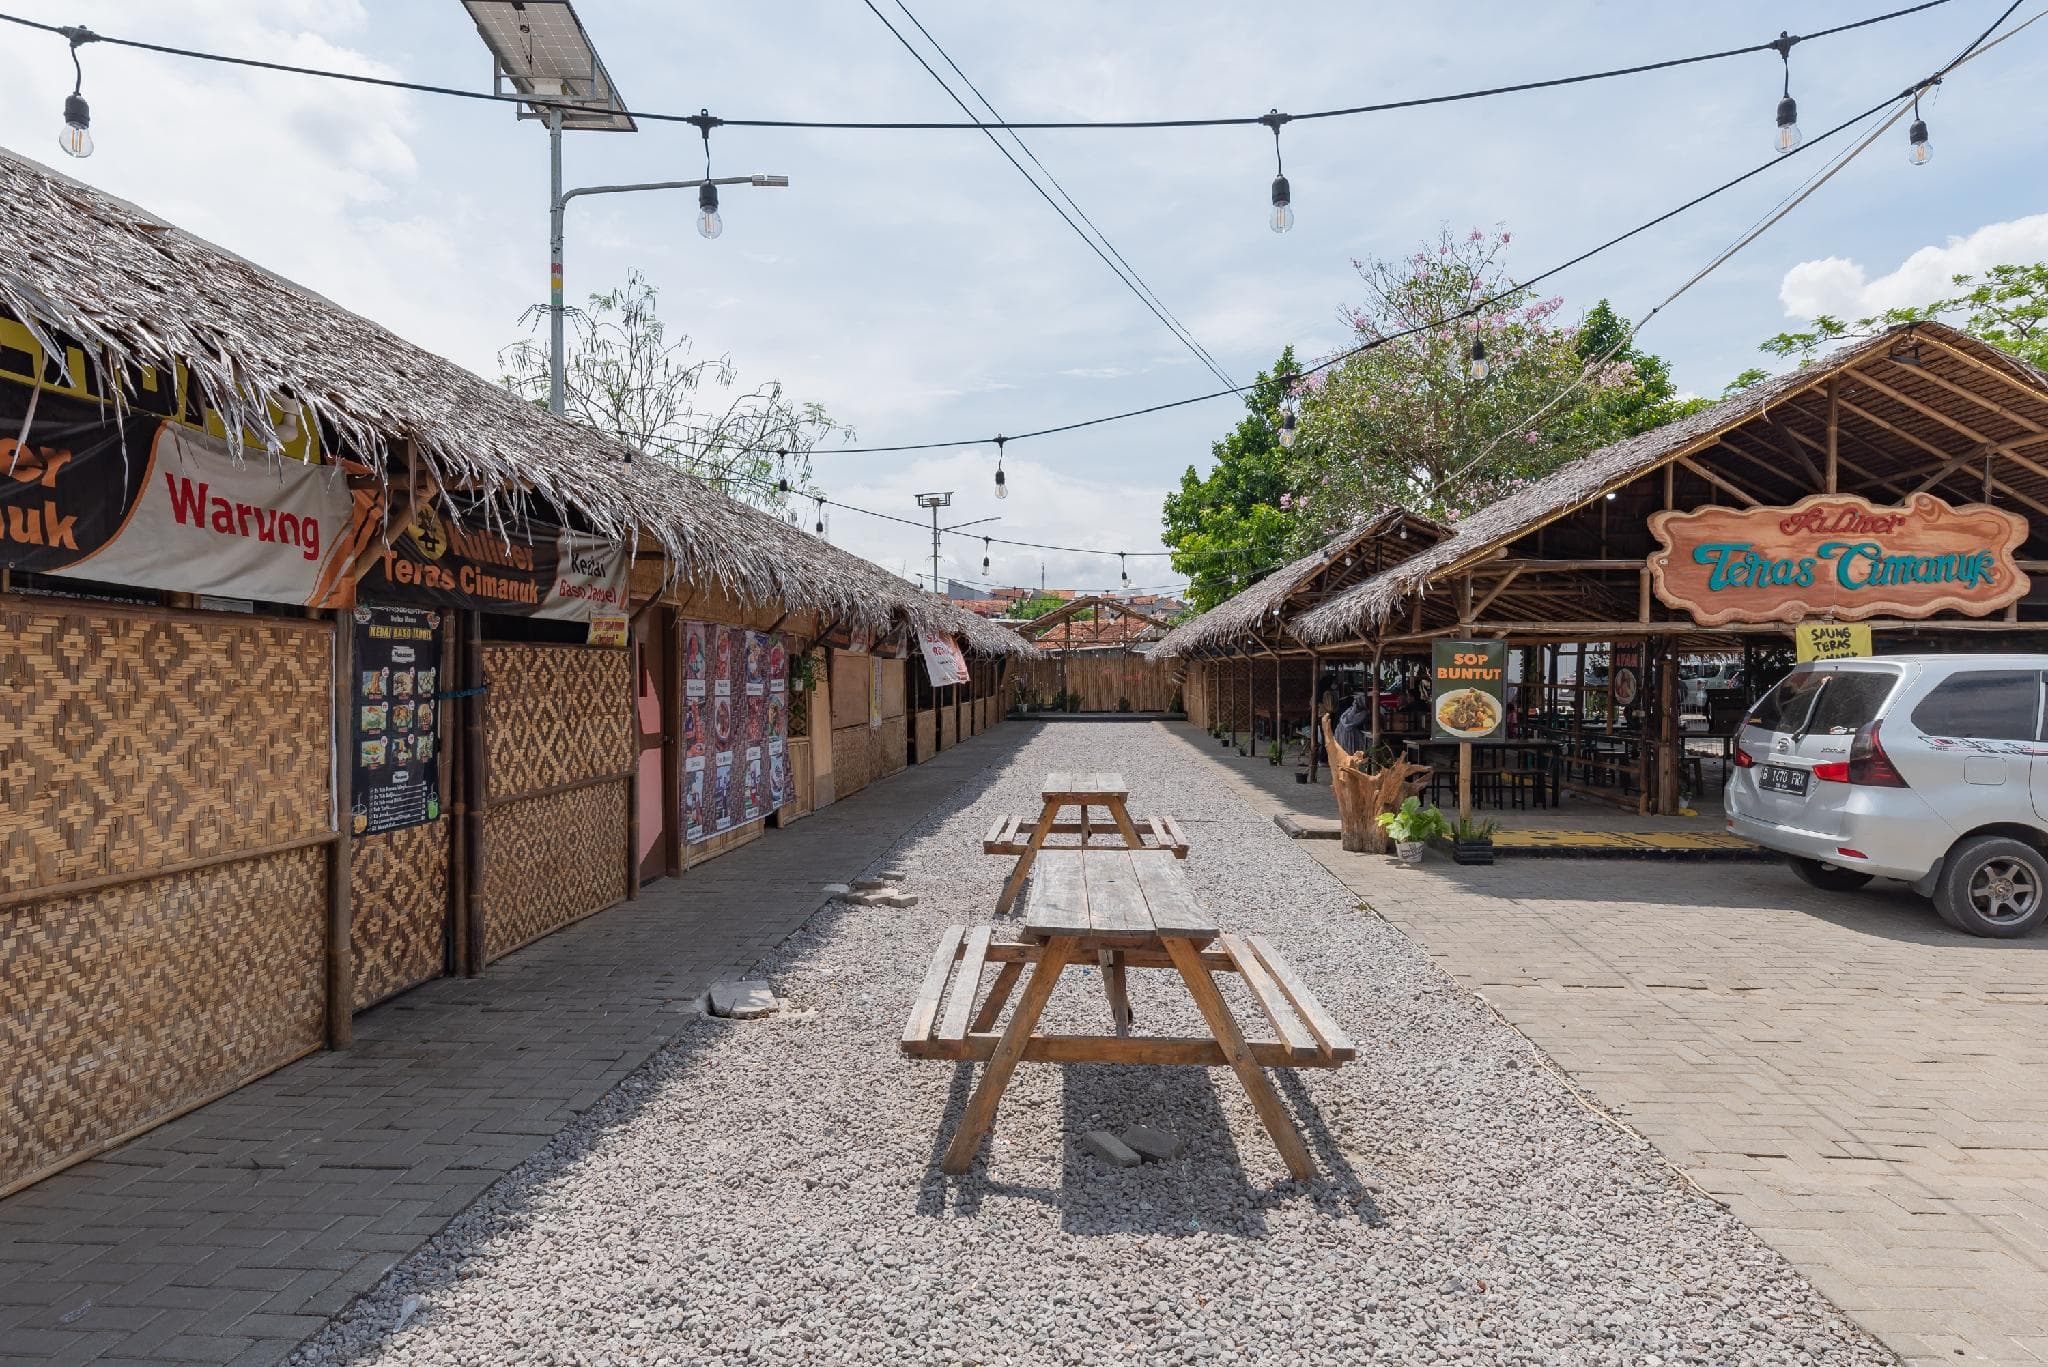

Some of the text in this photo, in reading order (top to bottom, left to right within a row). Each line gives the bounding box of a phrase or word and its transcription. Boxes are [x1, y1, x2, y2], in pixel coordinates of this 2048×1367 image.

[165, 472, 320, 561] Warung
[571, 553, 606, 578] Kedai
[1693, 542, 1996, 592] Teras Cimanuk
[382, 549, 538, 604] Teras Cimanuk
[559, 579, 586, 599] Baso
[1811, 627, 1852, 641] SAUNG
[1813, 639, 1851, 652] TERAS
[1454, 653, 1489, 667] SOP
[1437, 667, 1501, 680] BUNTUT
